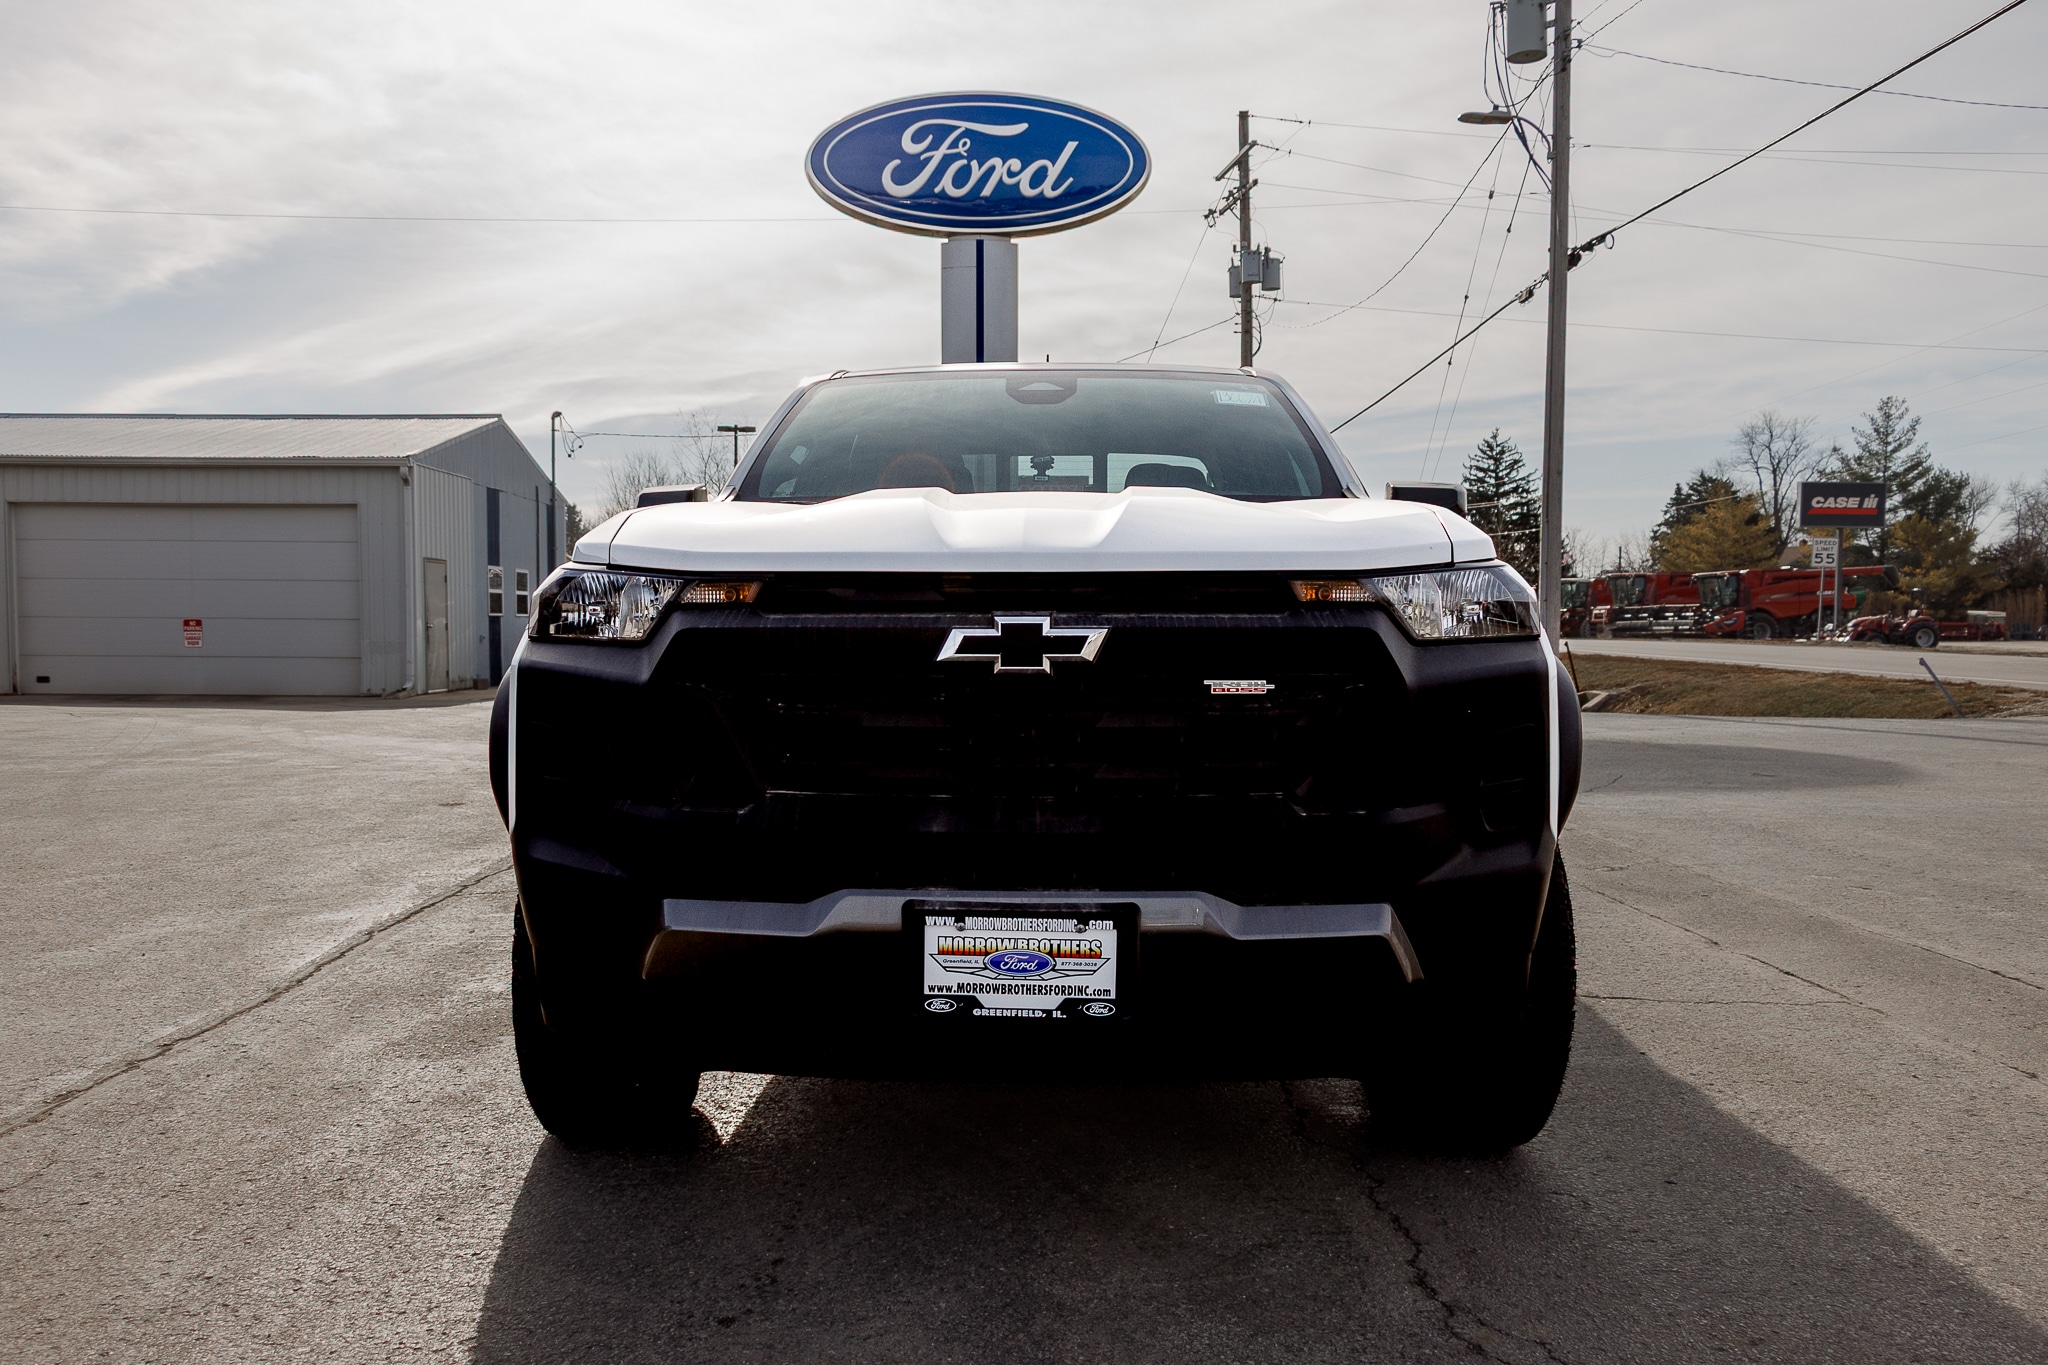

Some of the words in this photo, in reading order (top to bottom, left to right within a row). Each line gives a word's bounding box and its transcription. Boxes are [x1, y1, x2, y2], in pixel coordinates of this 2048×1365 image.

[881, 118, 1079, 198] Ford
[1811, 496, 1860, 508] CASE
[1814, 552, 1835, 564] 55
[937, 935, 1015, 956] MORROW
[1016, 937, 1103, 959] BROTHERS
[1000, 954, 1038, 971] Ford
[927, 982, 1112, 997] www.MORROWBROTHERSFORDINC.com
[930, 1000, 951, 1010] Ford
[1089, 1004, 1110, 1014] Ford
[972, 1008, 1047, 1018] GREENFIELD,
[1052, 1010, 1067, 1018] IL.
